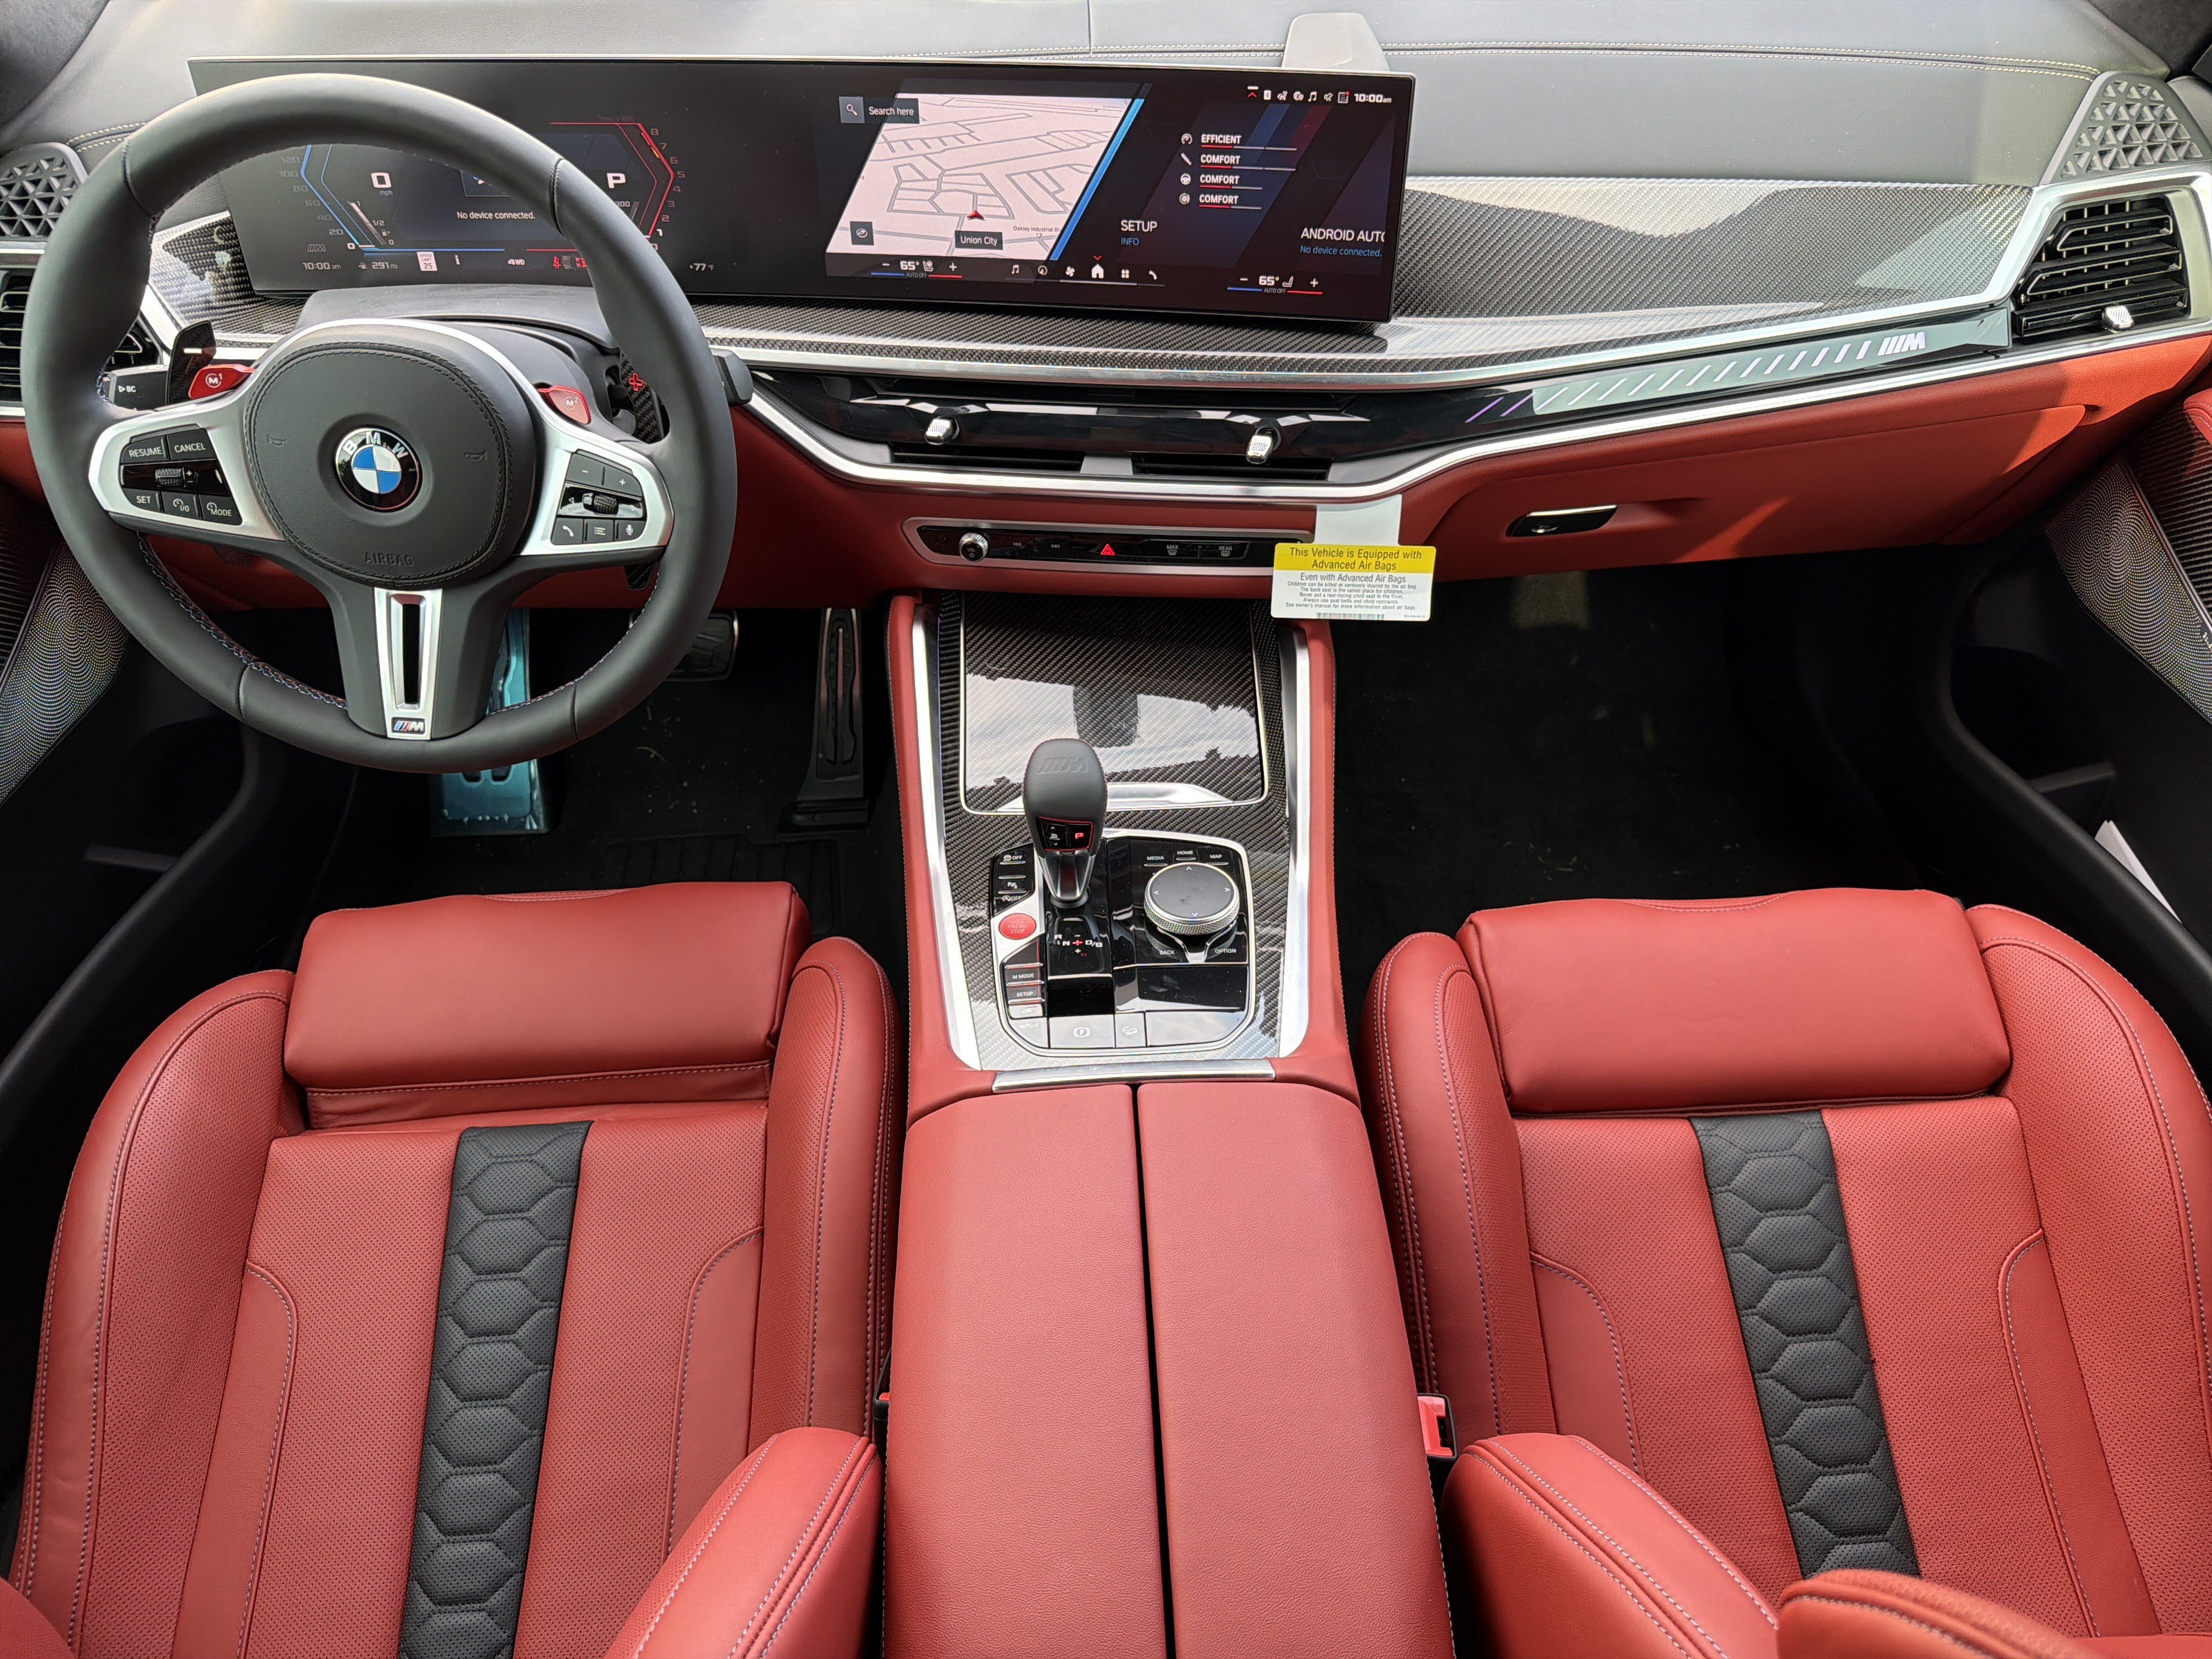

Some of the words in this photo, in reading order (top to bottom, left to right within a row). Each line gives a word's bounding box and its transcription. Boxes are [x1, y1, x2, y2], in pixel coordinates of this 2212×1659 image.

[868, 106, 895, 116] Search
[897, 108, 914, 116] here
[1201, 134, 1242, 144] EFFICIENT
[1200, 154, 1241, 165] COMFORT
[370, 172, 392, 188] 0
[606, 173, 626, 189] P
[1200, 174, 1240, 184] COMFORT
[1199, 194, 1239, 205] COMFORT
[469, 211, 493, 219] device
[495, 212, 536, 220] connected.
[1120, 219, 1158, 232] SETUP
[1300, 227, 1355, 241] ANDROID
[960, 235, 982, 245] Union
[984, 236, 998, 247] City
[1121, 237, 1139, 246] INFO
[1300, 245, 1311, 254] No
[1313, 246, 1338, 256] device
[1339, 248, 1382, 257] connected.
[174, 442, 207, 453] CANCEL
[342, 432, 409, 459] BMW
[129, 447, 162, 458] RESUME
[136, 495, 151, 504] SET
[211, 508, 232, 517] MODE
[364, 552, 415, 567] AIRBAG
[1290, 548, 1308, 556] This
[1312, 548, 1344, 558] Vehicle
[1347, 549, 1355, 558] is
[1357, 549, 1400, 560] Equipped
[1402, 550, 1422, 560] with
[1312, 559, 1356, 569] Advanced
[1358, 561, 1372, 570] Air
[1374, 561, 1396, 572] Bags
[1319, 573, 1335, 582] with
[1338, 573, 1373, 582] Advanced
[1375, 574, 1386, 583] Air
[1388, 575, 1406, 584] Bags
